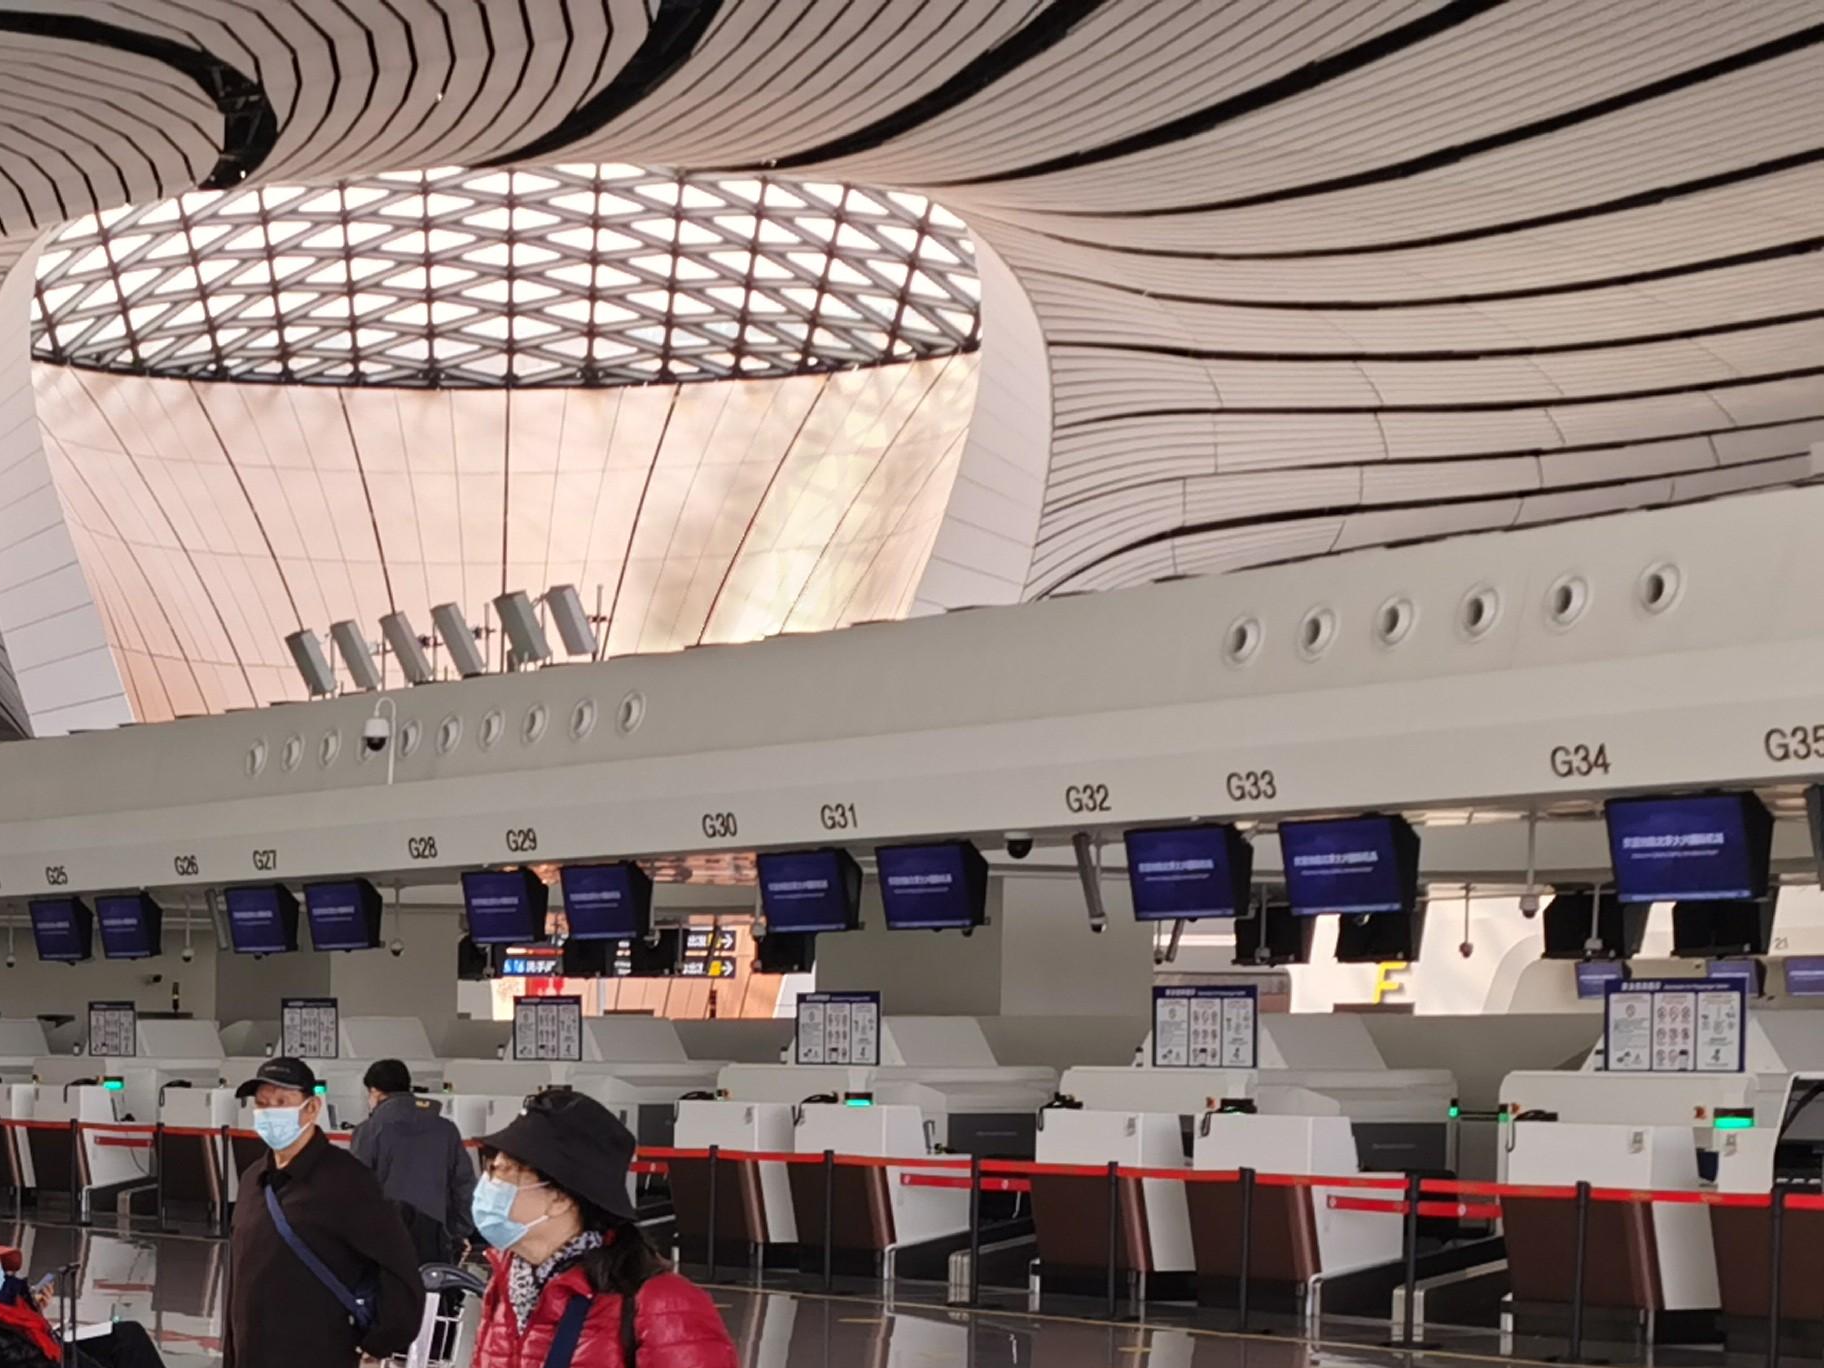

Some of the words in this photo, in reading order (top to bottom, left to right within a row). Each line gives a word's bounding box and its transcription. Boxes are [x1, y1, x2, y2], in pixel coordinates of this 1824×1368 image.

[1764, 724, 1824, 762] G35
[1550, 743, 1611, 778] G34
[1065, 783, 1112, 814] G32
[1226, 769, 1277, 802] G33
[702, 812, 738, 839] G30
[820, 803, 858, 830] G31
[408, 836, 438, 860] G28
[505, 827, 538, 853] G29
[174, 854, 199, 877] G26
[252, 849, 277, 871] G27
[45, 865, 69, 886] G25
